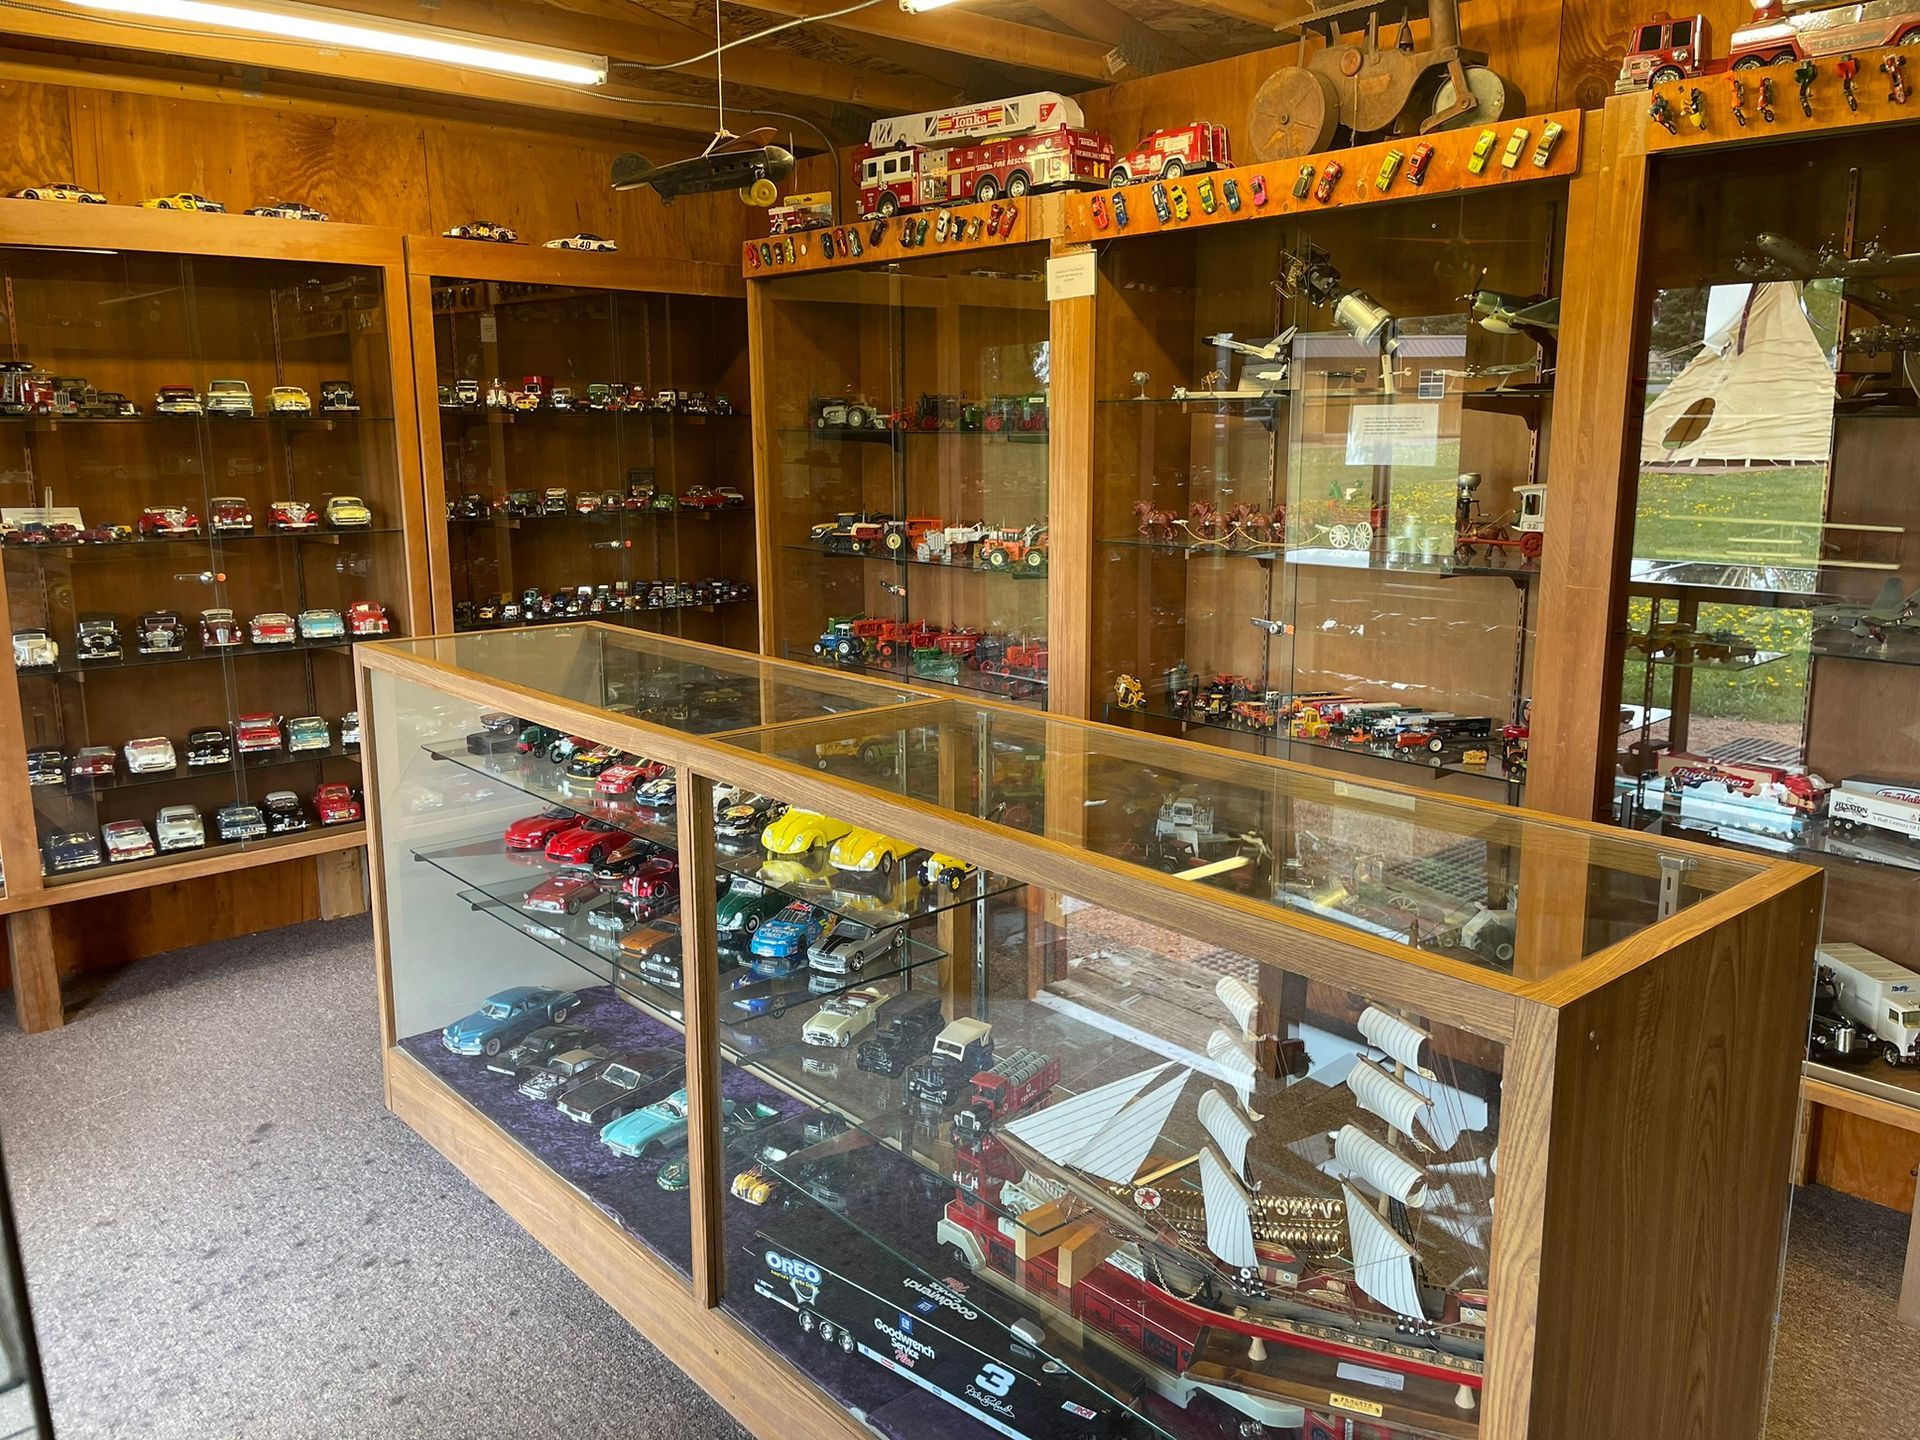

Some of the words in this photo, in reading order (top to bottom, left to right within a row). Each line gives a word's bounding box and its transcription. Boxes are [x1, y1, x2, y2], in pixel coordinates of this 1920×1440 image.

[952, 112, 988, 129] Tonka
[993, 159, 1006, 168] FIRE
[55, 190, 66, 199] 3
[181, 199, 194, 209] 3
[285, 209, 302, 220] 24
[477, 226, 490, 236] 40
[578, 240, 591, 250] 40
[1675, 767, 1750, 788] Budweiser
[818, 918, 829, 930] 5
[765, 1251, 822, 1286] OREO
[902, 1278, 978, 1320] Goodwrench
[874, 1318, 935, 1359] Goodwrench
[891, 1337, 919, 1360] Service
[975, 1363, 1016, 1397] 3
